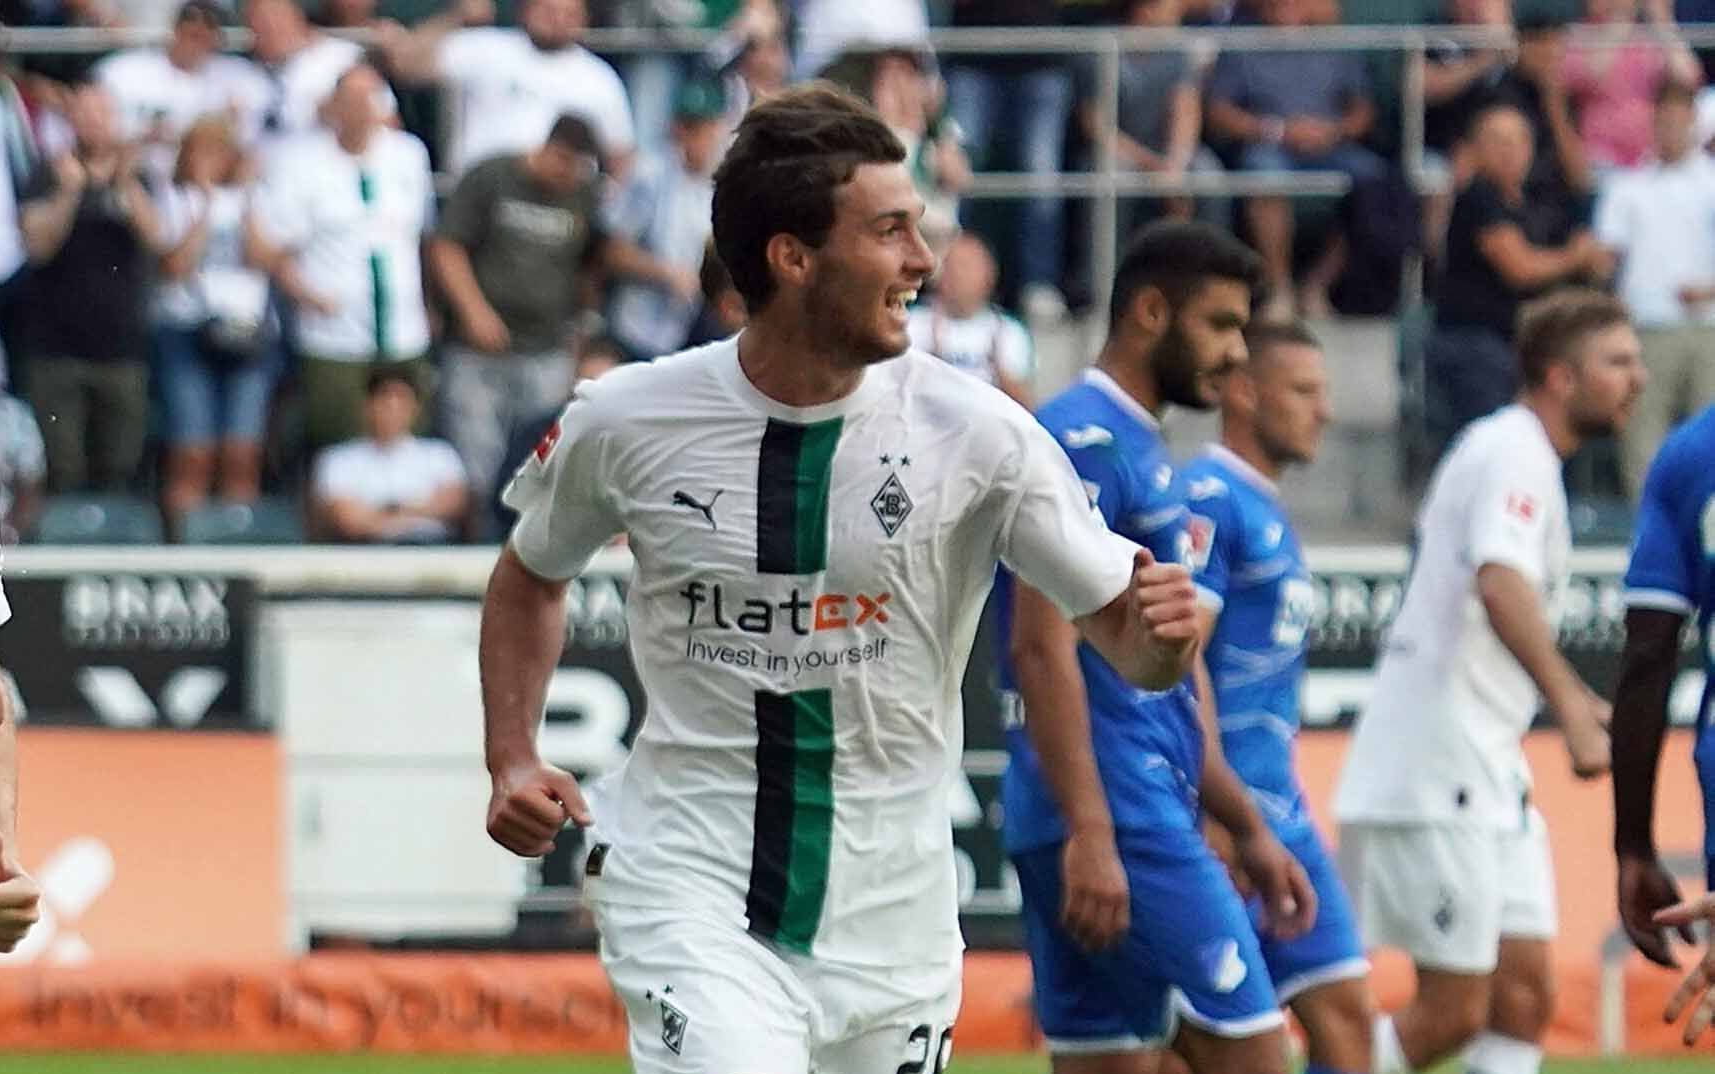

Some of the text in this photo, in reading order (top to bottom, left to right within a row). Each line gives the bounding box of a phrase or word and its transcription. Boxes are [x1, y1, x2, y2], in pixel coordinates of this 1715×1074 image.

[687, 635, 887, 677] Invest in yourself
